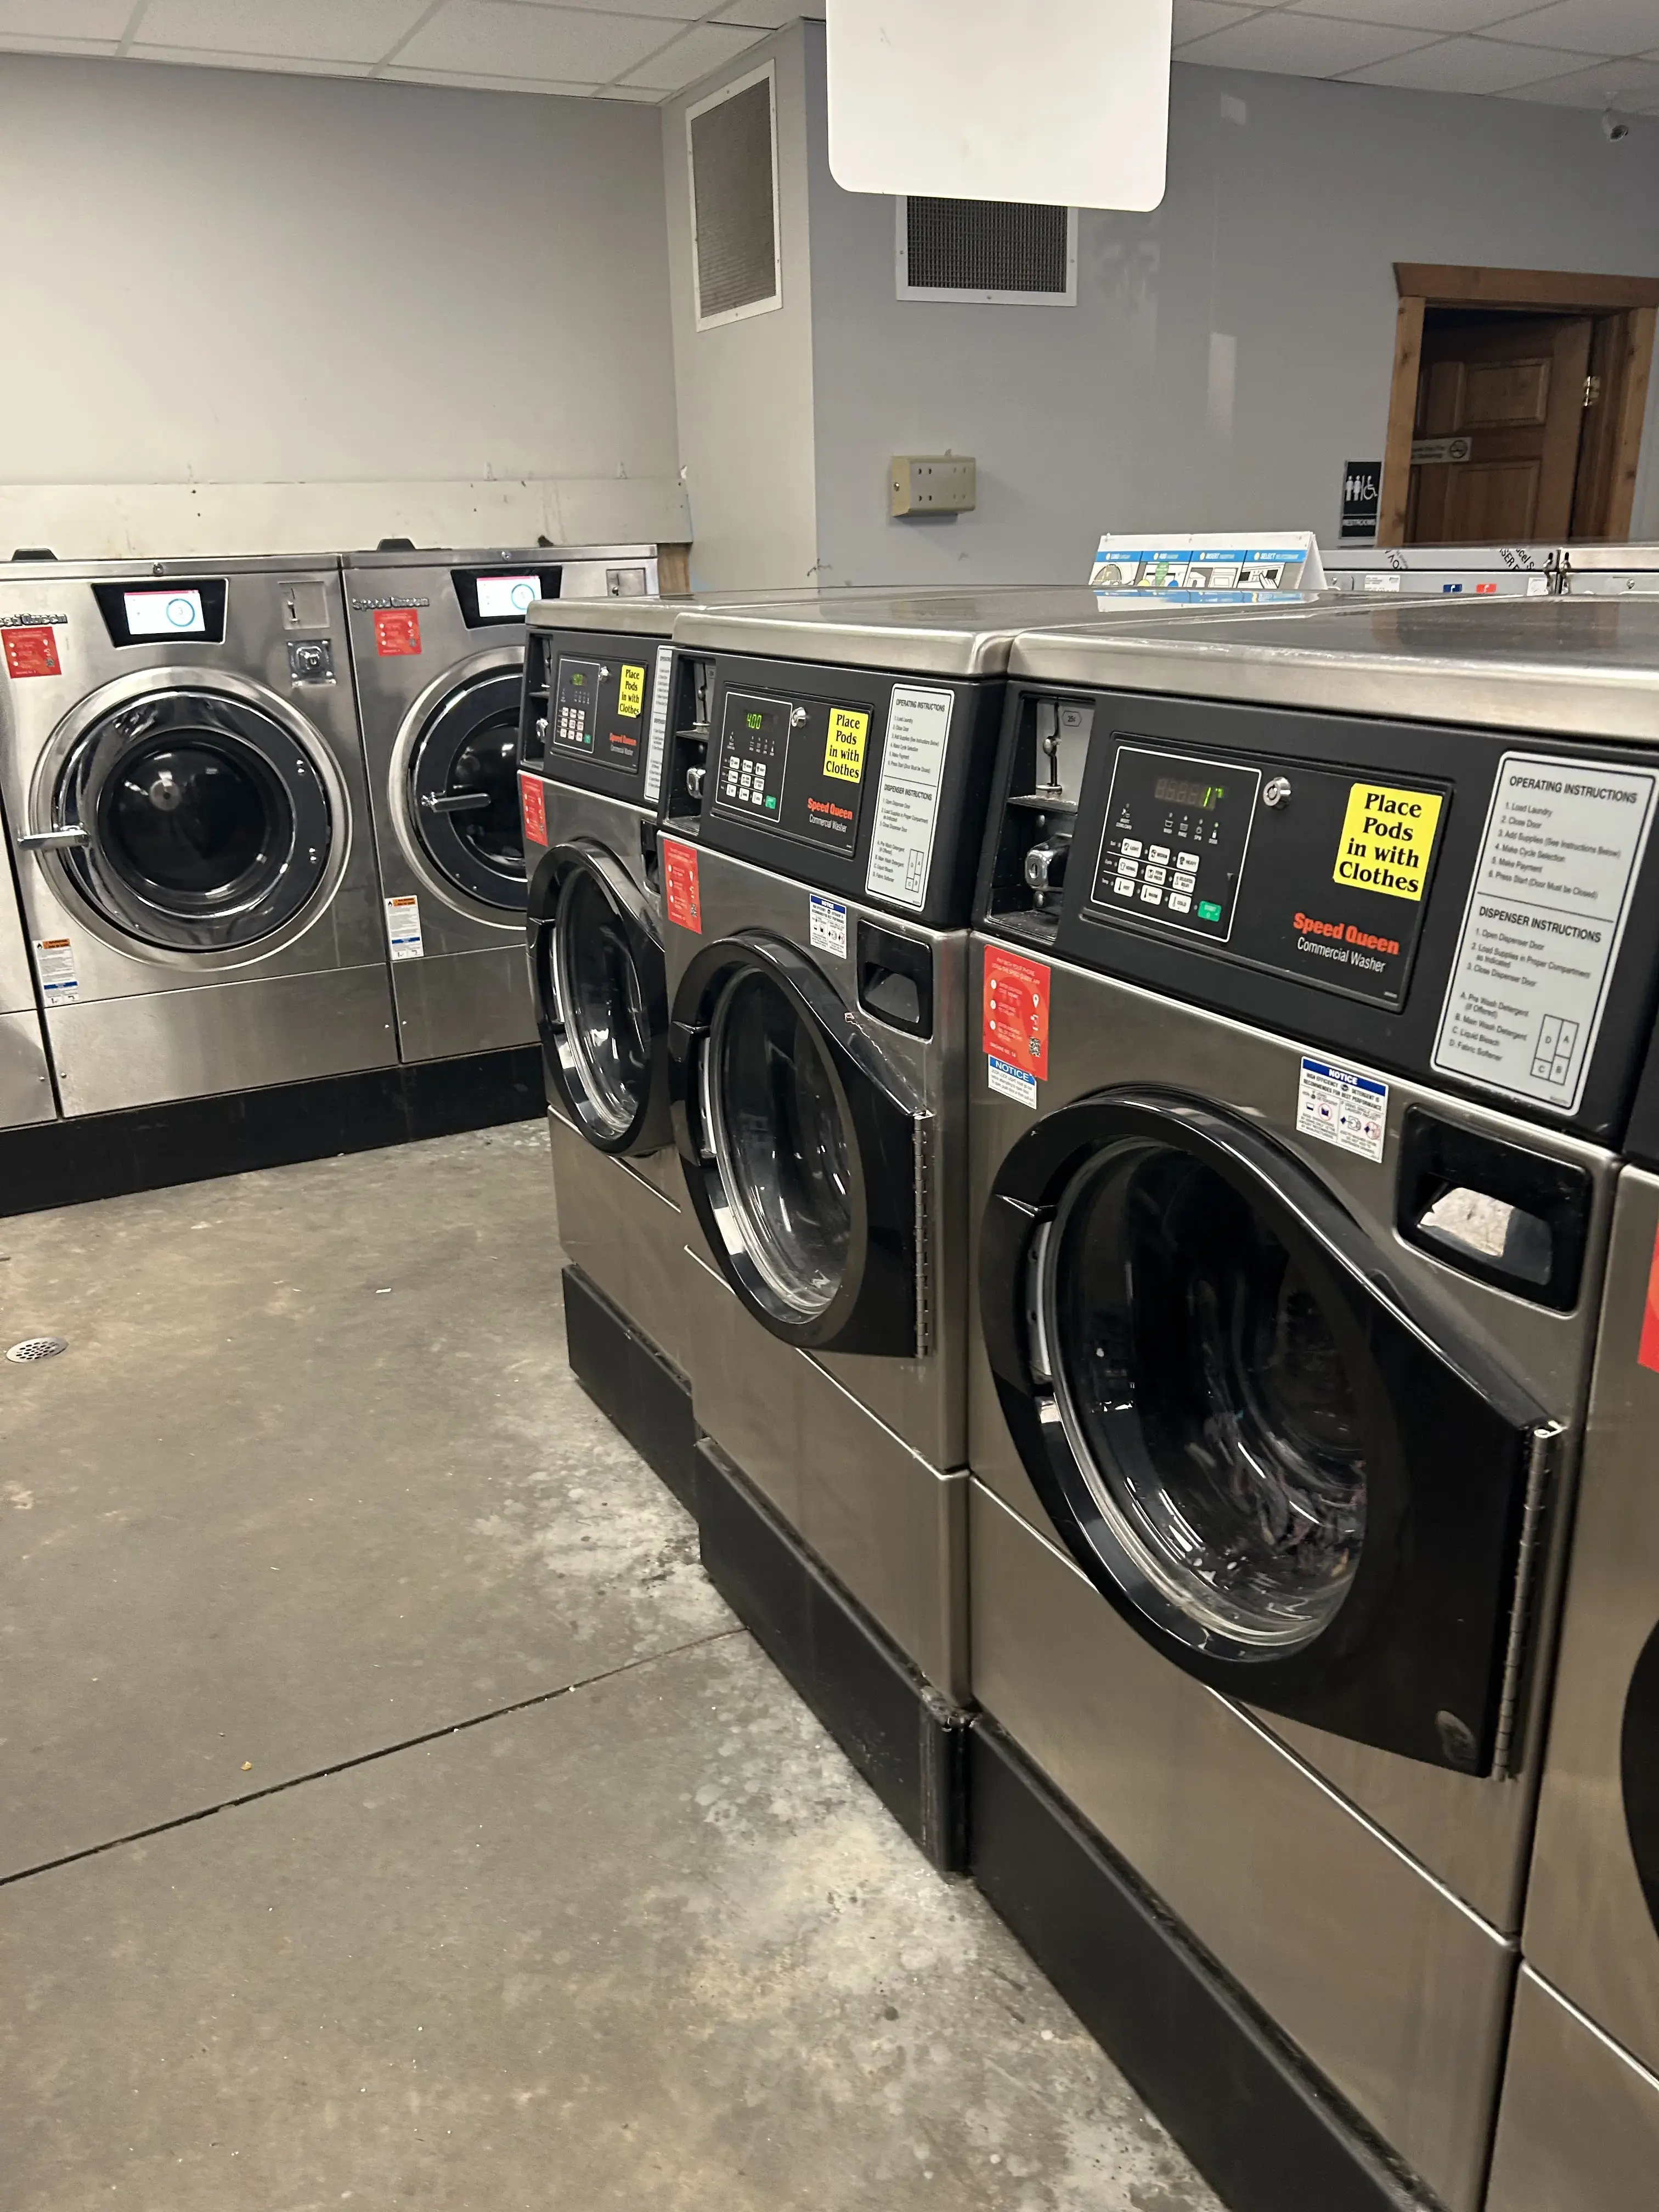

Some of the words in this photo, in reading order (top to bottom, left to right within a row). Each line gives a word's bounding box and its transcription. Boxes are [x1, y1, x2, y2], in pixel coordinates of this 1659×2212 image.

[625, 669, 640, 680] Place
[625, 681, 638, 691] Pods
[629, 693, 640, 704] with
[619, 703, 640, 715] Clothes
[837, 714, 860, 730] Place
[836, 730, 857, 746] Pods
[830, 745, 839, 757] in
[840, 748, 860, 763] with
[826, 761, 860, 778] Clothes
[1508, 776, 1562, 793] OPERATING
[1564, 783, 1638, 803] INSTRUCTIONS
[807, 798, 830, 814] Speed
[830, 803, 853, 820] Queen
[1364, 792, 1423, 818] Place
[1511, 803, 1527, 812] Load
[1526, 805, 1554, 818] Laundry
[1362, 816, 1414, 842] Pods
[1508, 816, 1526, 826] Close
[1526, 819, 1542, 829] Door
[1347, 837, 1369, 857] in
[1374, 845, 1420, 868] with
[1339, 860, 1420, 893] Clothes
[1479, 906, 1530, 926] DISPENSER
[1531, 918, 1602, 943] INSTRUCTIONS
[1293, 912, 1344, 940] Speed
[1345, 924, 1401, 955] Queen
[1481, 929, 1498, 940] Open
[1498, 933, 1528, 948] Dispenser
[1528, 940, 1545, 951] Door
[1297, 936, 1349, 962] Commercial
[1350, 950, 1386, 973] Washer
[1477, 944, 1493, 954] Load
[1473, 964, 1491, 975] Close
[1521, 977, 1537, 987] Door
[1545, 1035, 1552, 1044] D
[1563, 1035, 1570, 1043] A
[996, 1059, 1029, 1082] NOTICE
[1328, 1069, 1358, 1085] NOTICE
